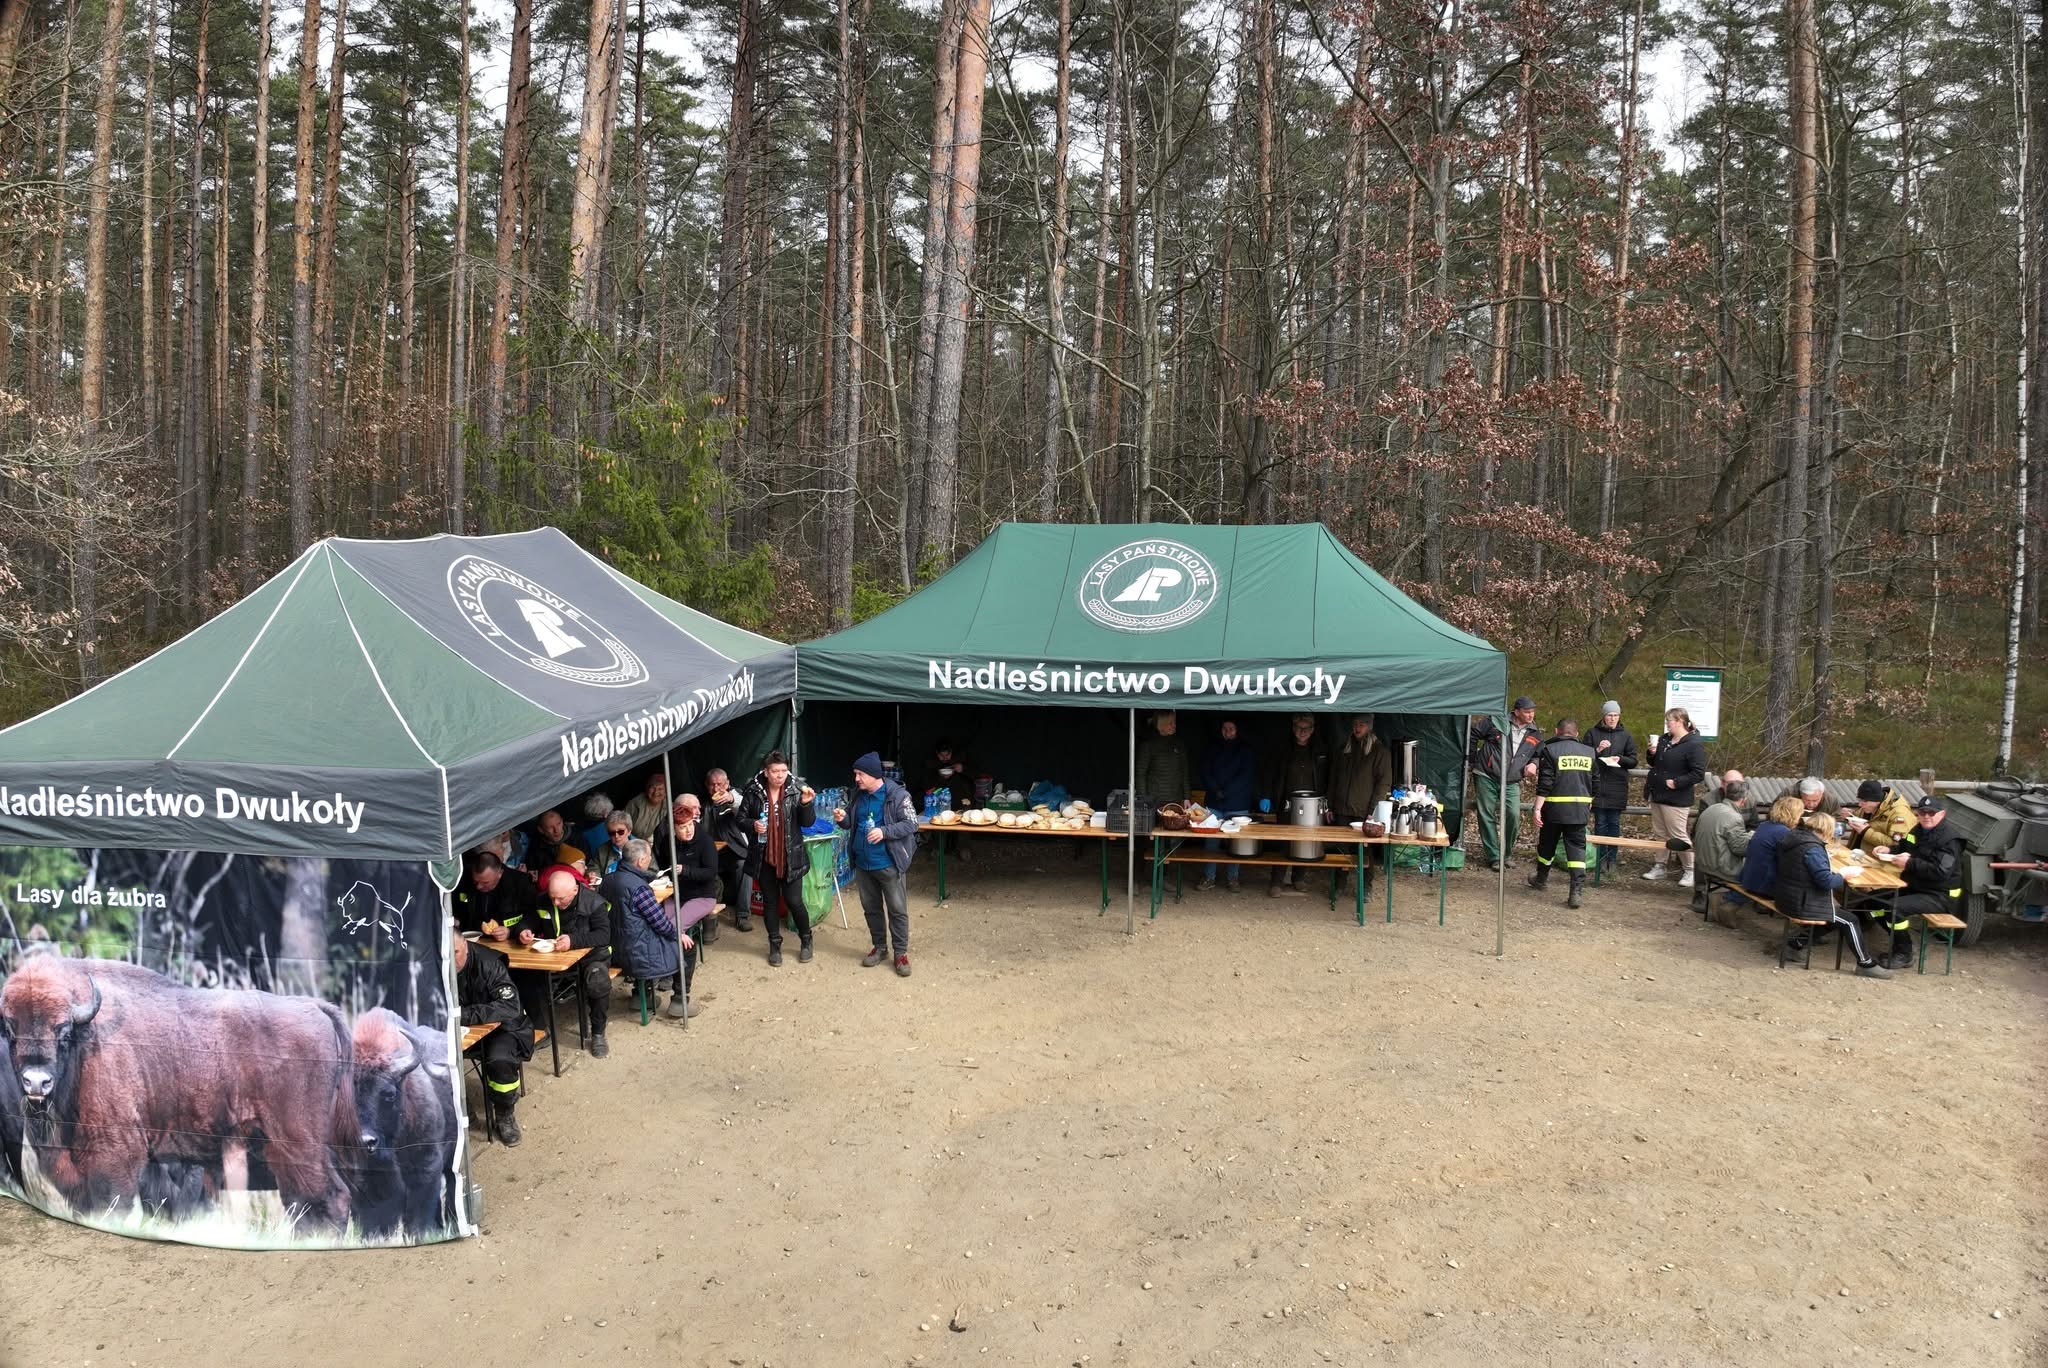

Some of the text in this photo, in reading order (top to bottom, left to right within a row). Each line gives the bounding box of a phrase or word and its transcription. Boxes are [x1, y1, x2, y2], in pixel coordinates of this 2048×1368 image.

[1090, 543, 1209, 587] LASY PAŃSTWOWE
[458, 560, 583, 637] LASY PAŃSTWOWE
[928, 659, 1346, 704] Nadleśnictwo Dwukoły
[560, 667, 754, 777] Nadleśnictwo Dwukoły
[216, 788, 365, 833] Dwukoły
[17, 883, 166, 909] Lasy dla żubra
